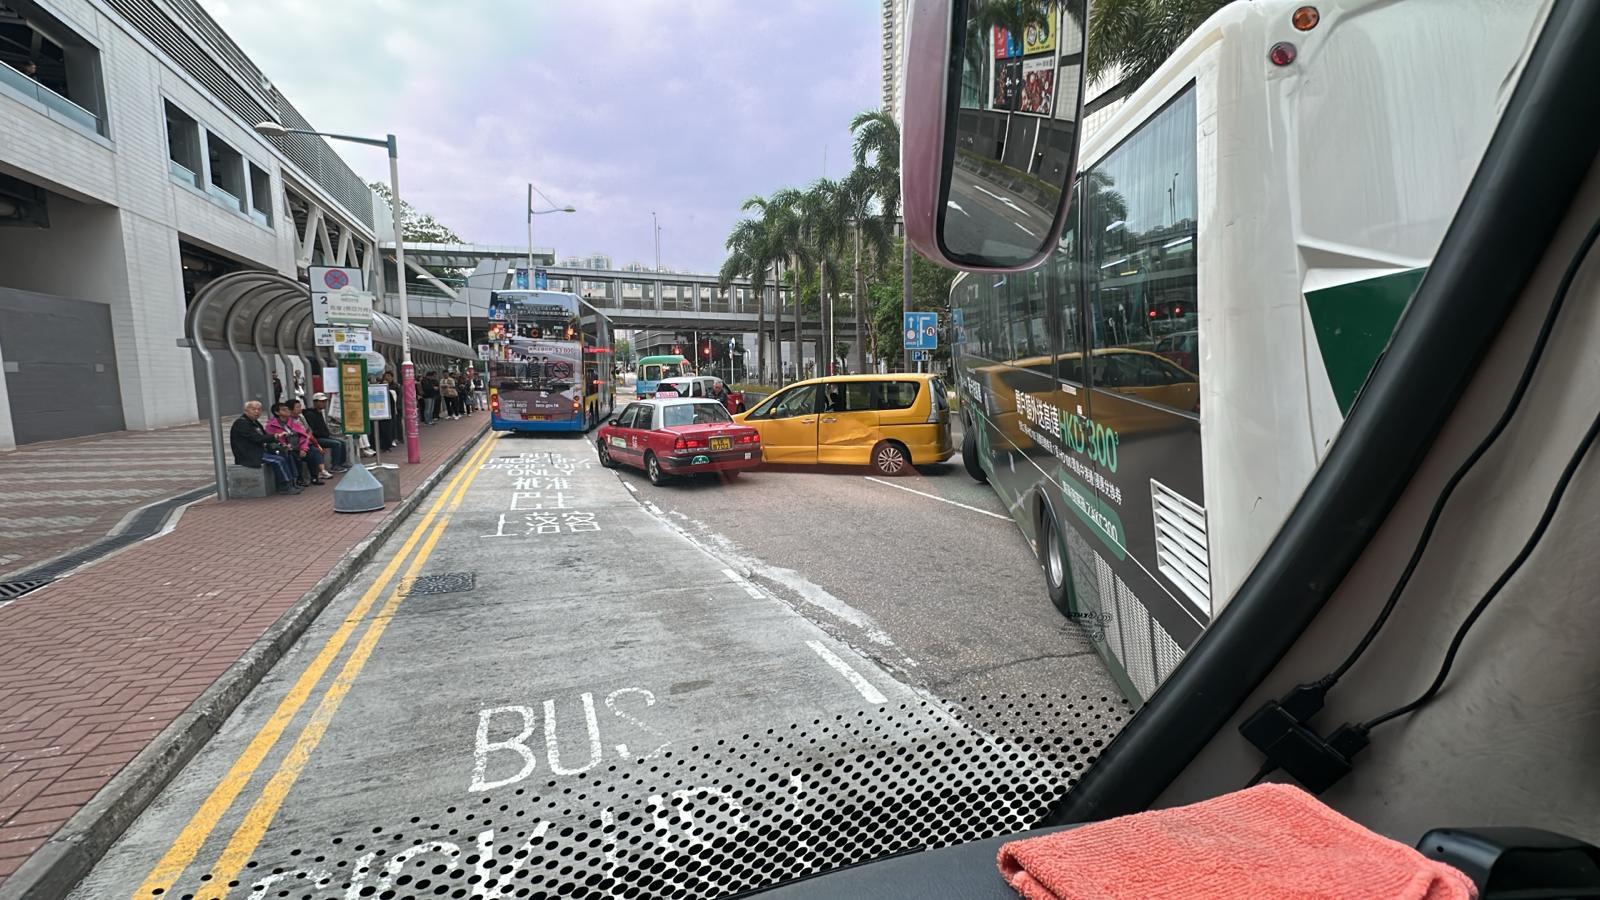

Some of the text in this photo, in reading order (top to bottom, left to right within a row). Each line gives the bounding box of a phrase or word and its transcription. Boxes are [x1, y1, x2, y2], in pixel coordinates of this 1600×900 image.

[914, 351, 921, 360] P
[507, 468, 575, 477] ONLY
[510, 491, 576, 511] 巴士
[480, 510, 602, 538] 上落客
[468, 687, 672, 792] BUS
